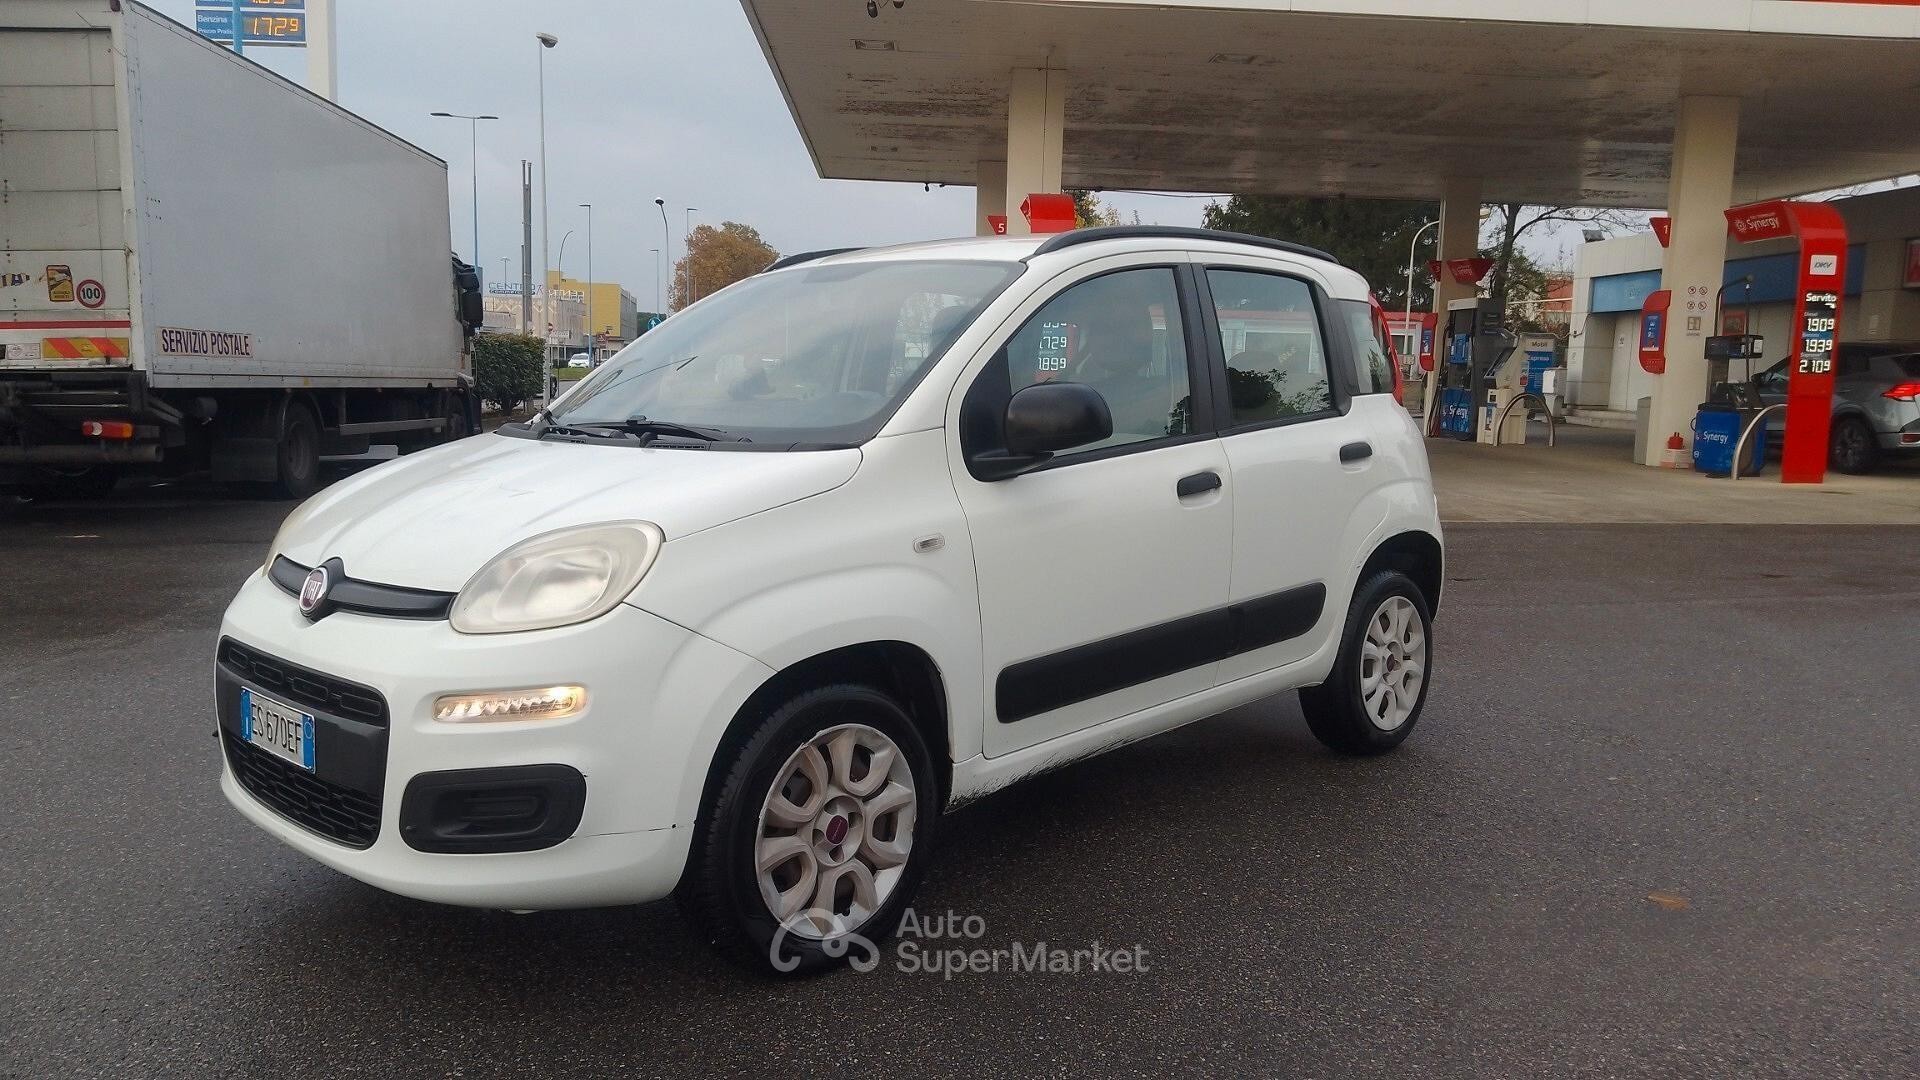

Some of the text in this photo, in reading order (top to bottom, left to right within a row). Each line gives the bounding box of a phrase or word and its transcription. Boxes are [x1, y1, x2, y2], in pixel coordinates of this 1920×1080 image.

[198, 15, 228, 24] Benzina
[998, 223, 1005, 233] 5
[1663, 225, 1669, 234] 1
[1747, 216, 1779, 232] Synergy
[81, 288, 101, 300] 100
[1806, 293, 1837, 302] Servito
[161, 329, 251, 356] SERVIZIO POSTALE
[1703, 431, 1729, 444] Synergy
[303, 579, 322, 601] FIAT
